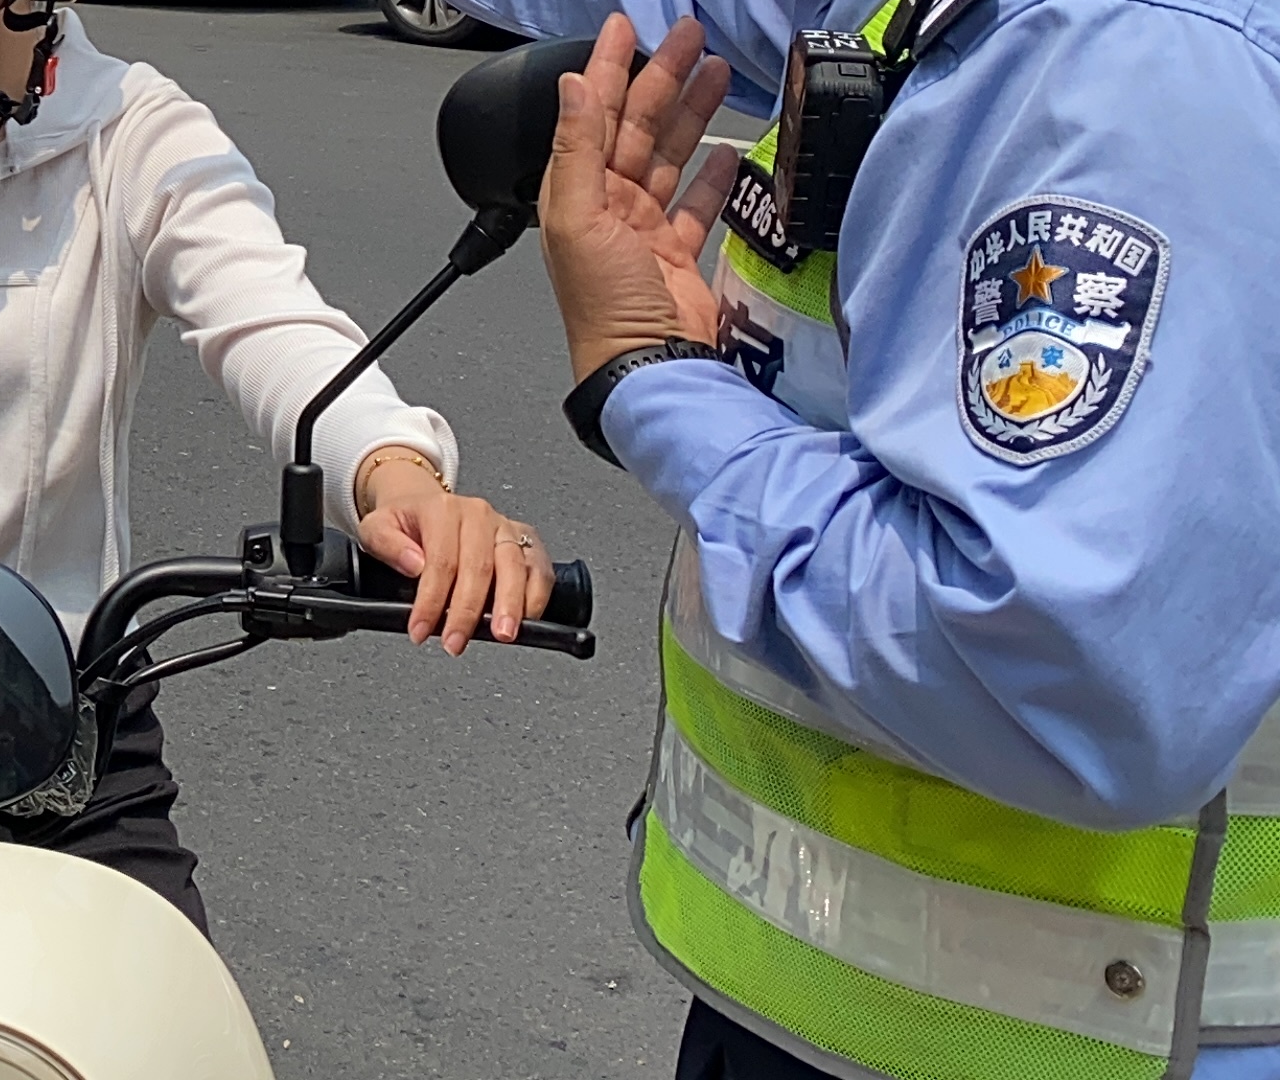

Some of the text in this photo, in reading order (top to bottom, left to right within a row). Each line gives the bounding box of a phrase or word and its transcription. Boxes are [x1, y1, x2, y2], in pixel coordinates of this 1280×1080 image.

[970, 210, 1153, 282] 中华人民共和国
[1003, 313, 1076, 339] POLICE
